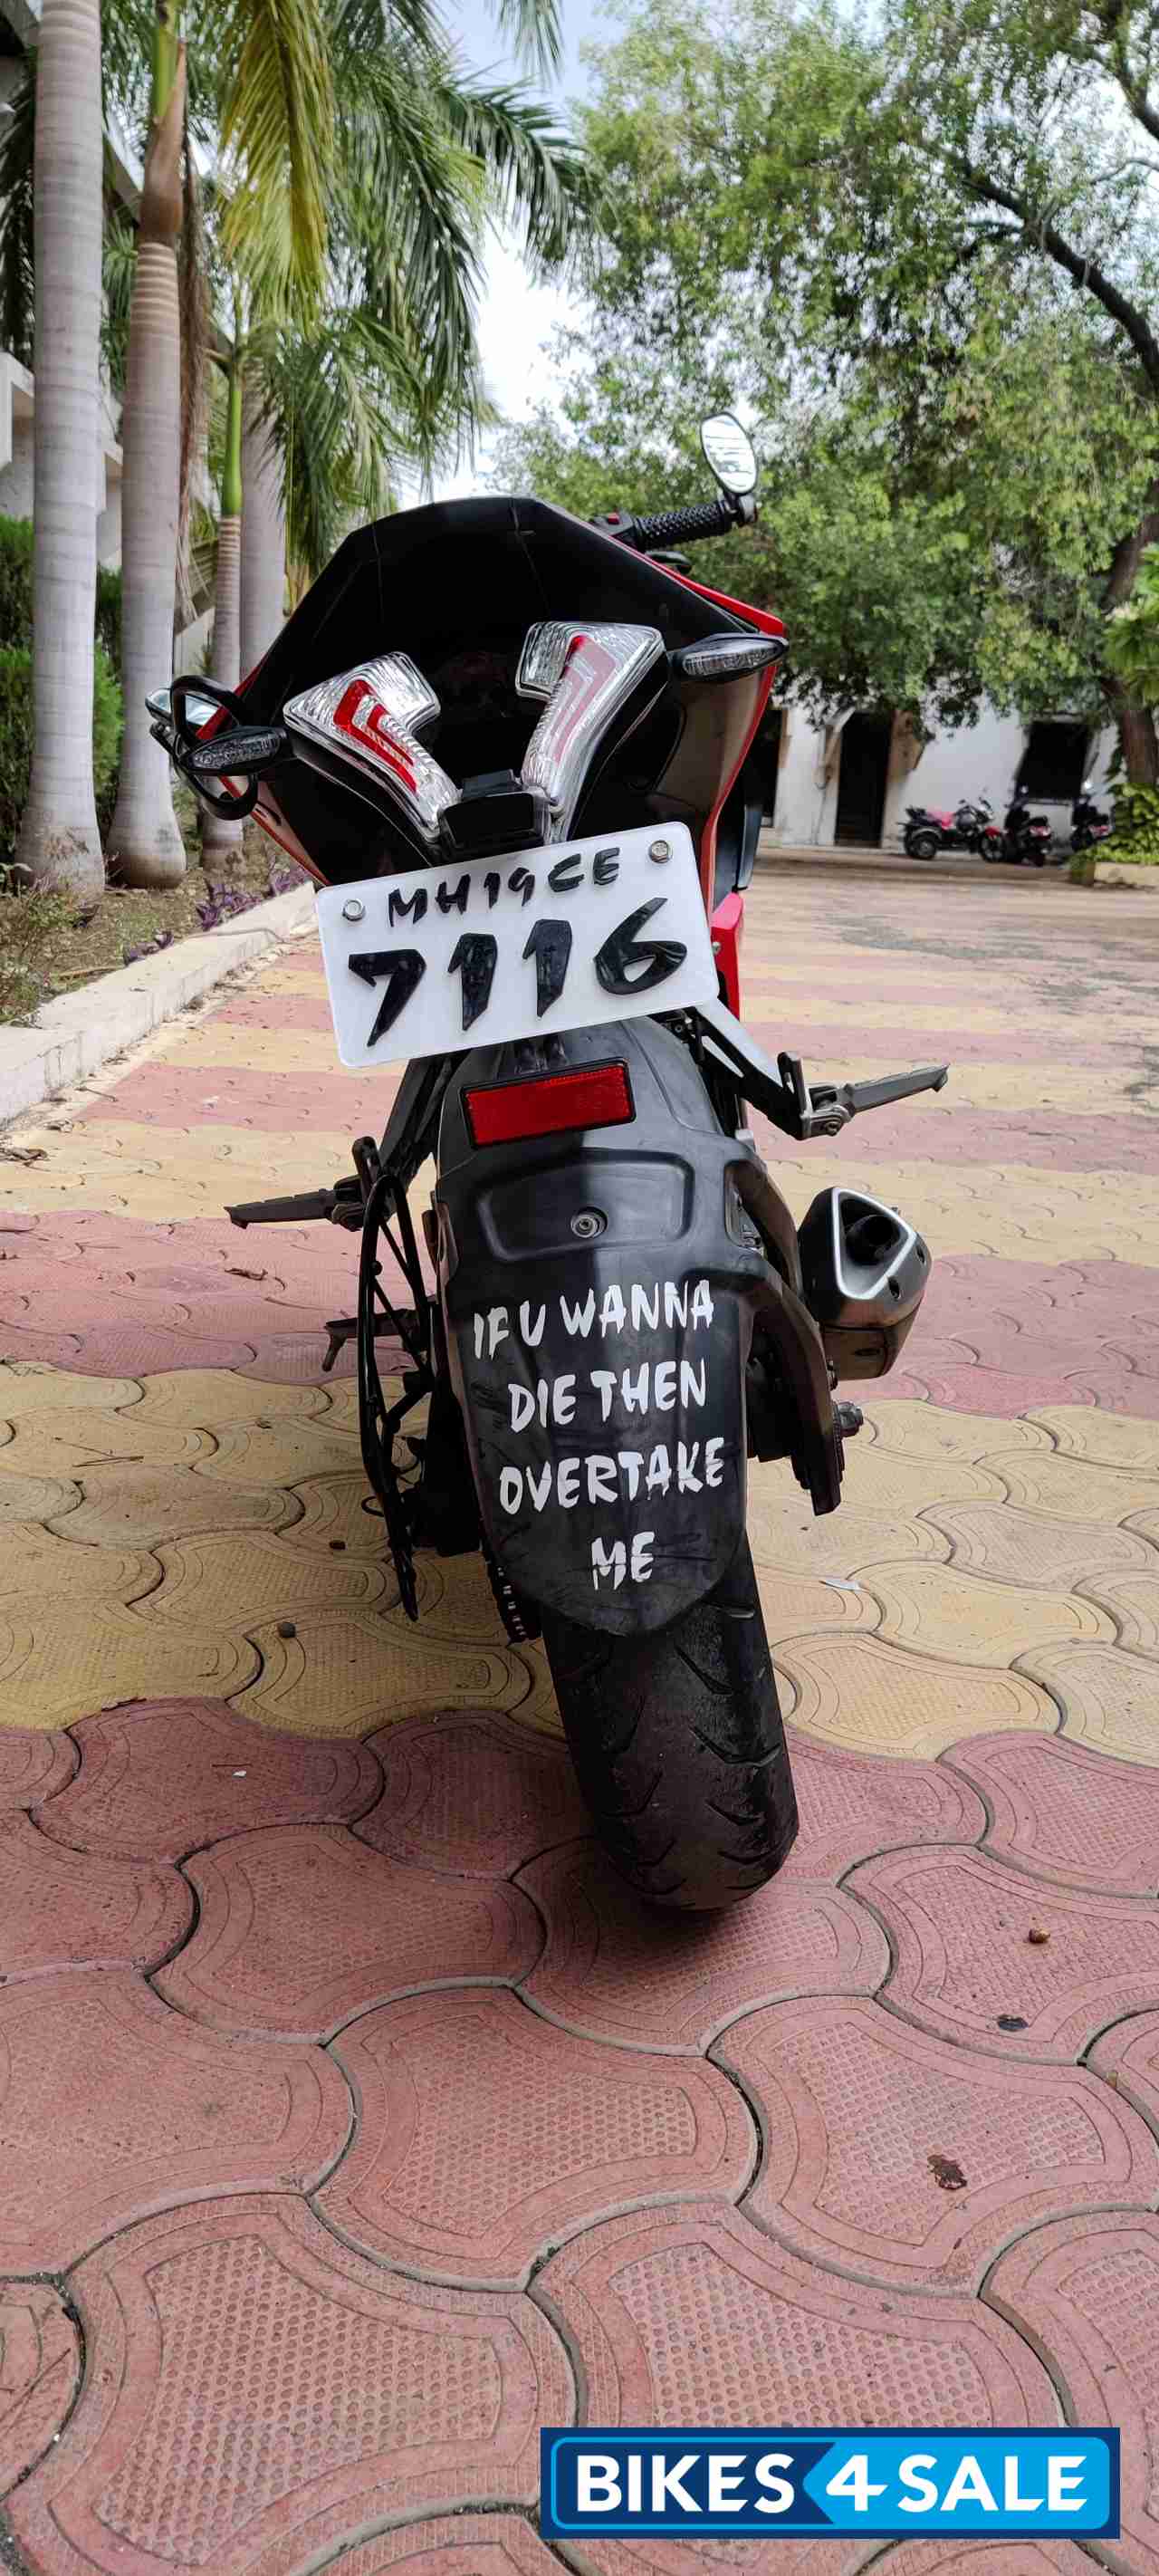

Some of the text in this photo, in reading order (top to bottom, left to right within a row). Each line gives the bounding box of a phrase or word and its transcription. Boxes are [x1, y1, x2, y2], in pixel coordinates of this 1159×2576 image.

[348, 897, 687, 1047] 7116
[474, 1279, 714, 1360] IF U WANNA
[508, 1359, 706, 1433] DIE THEN
[499, 1437, 724, 1514] OVERTAKE
[591, 1531, 655, 1590] ME
